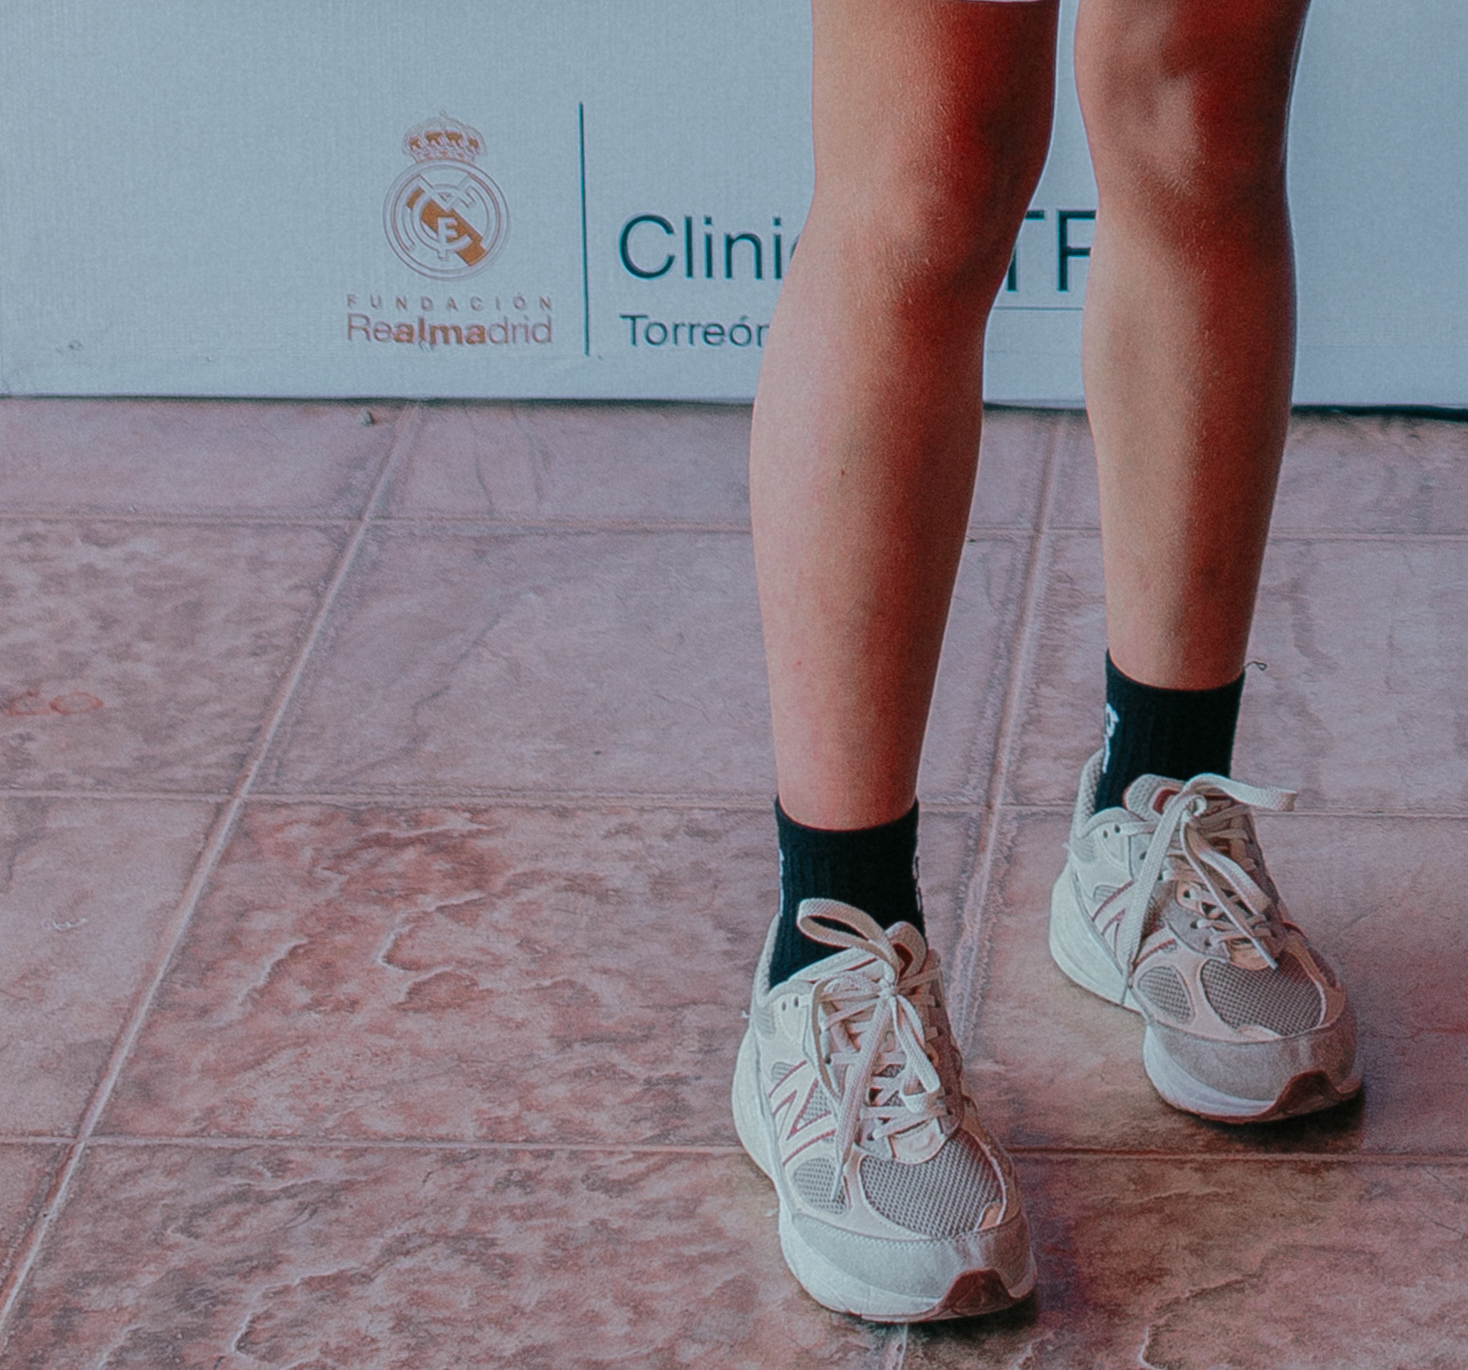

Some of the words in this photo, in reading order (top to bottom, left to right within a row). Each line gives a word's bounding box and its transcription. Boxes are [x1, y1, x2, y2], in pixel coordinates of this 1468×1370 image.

[618, 214, 801, 280] Clini
[347, 294, 552, 311] FUNDACIÓN
[347, 314, 552, 347] Realmadrid
